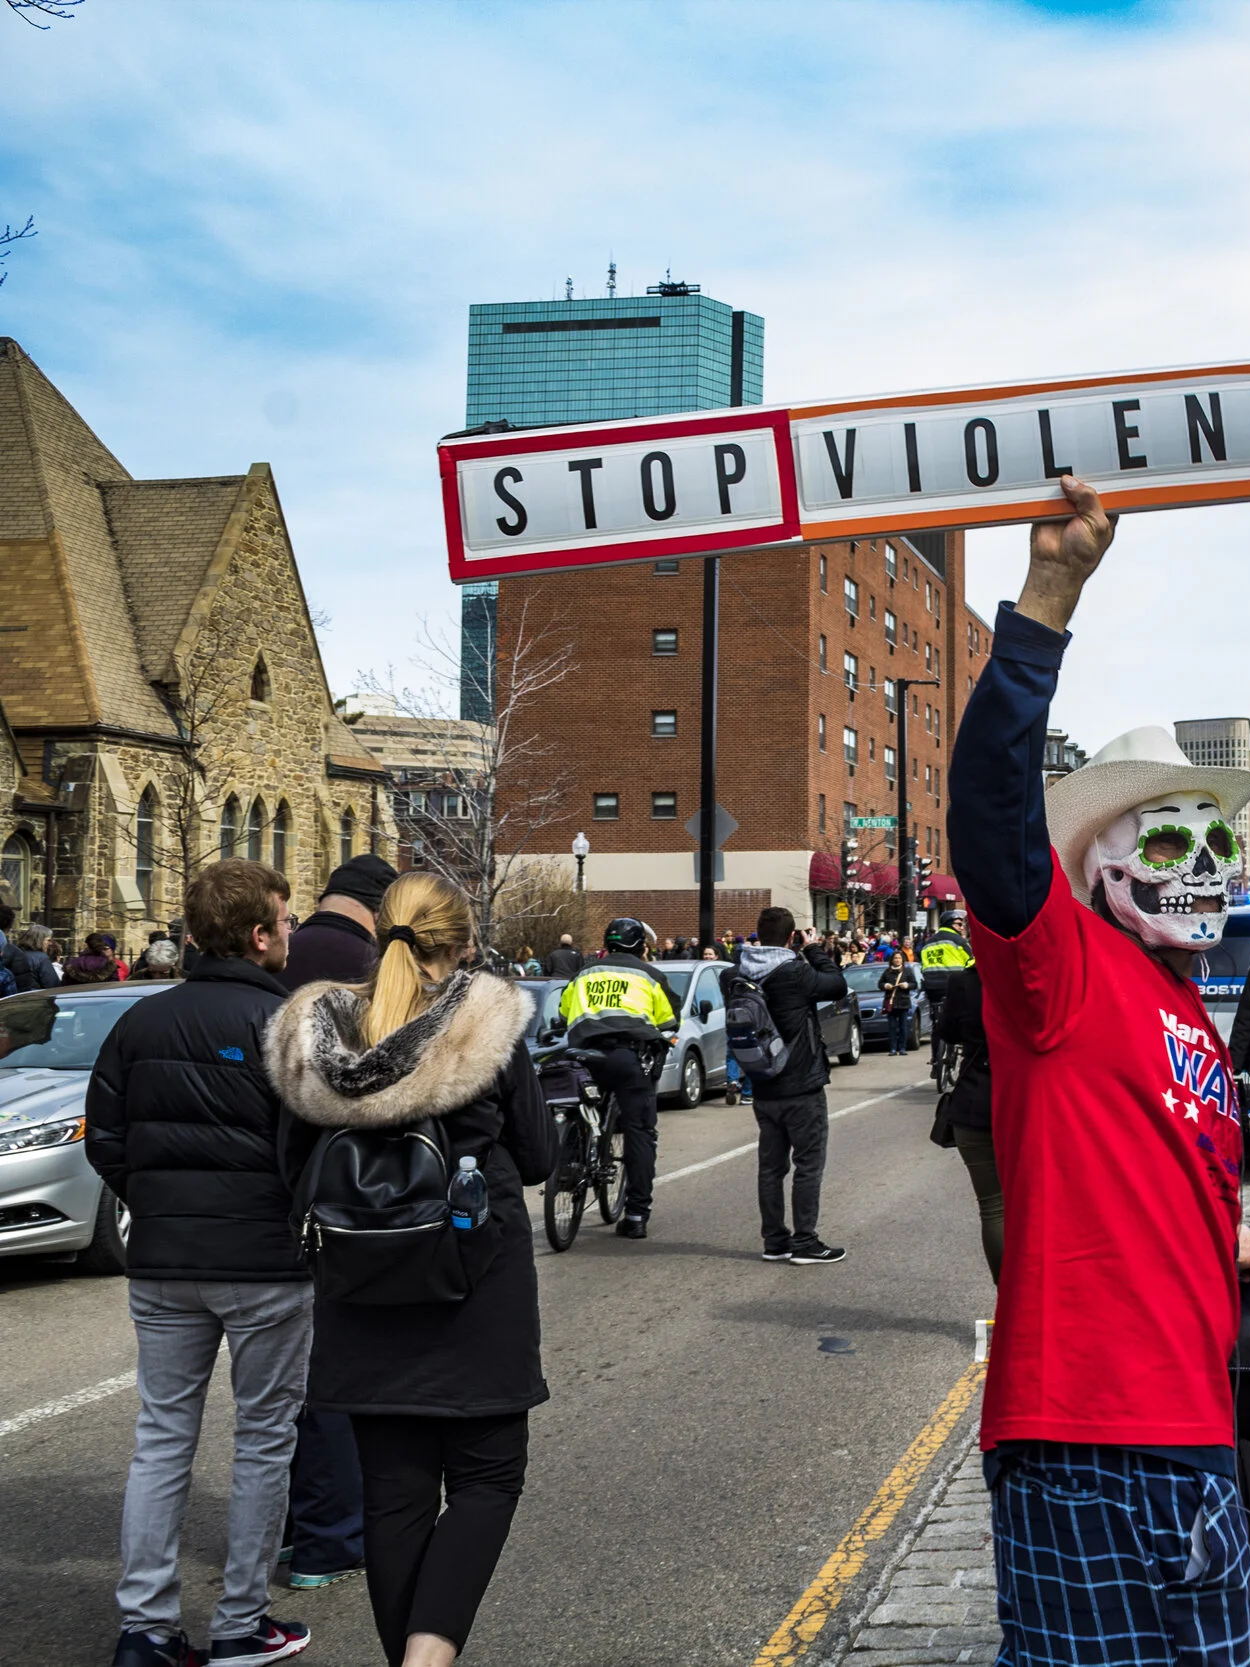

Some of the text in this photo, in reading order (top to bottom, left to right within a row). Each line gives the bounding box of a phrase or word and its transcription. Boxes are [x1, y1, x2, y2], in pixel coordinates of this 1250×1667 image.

[493, 442, 748, 537] STOP
[586, 979, 629, 995] BOSTON
[587, 994, 622, 1008] POLICE
